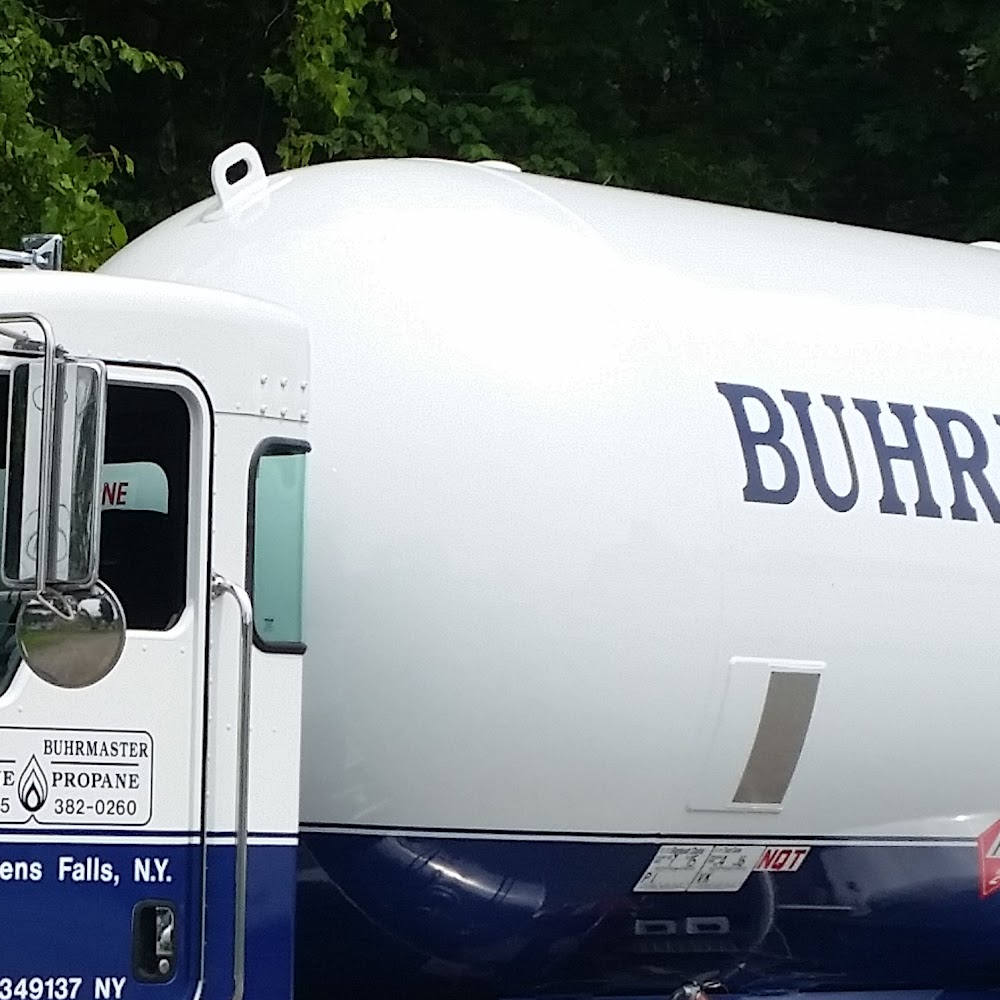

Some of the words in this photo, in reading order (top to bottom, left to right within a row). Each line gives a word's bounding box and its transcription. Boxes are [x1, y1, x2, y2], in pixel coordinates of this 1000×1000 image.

[715, 382, 1000, 523] BUHR
[101, 481, 129, 506] NE
[43, 739, 149, 758] BUHRMASTER
[51, 771, 140, 790] PROPANE
[54, 798, 137, 817] 382-0260
[58, 856, 120, 887] Falls,
[134, 857, 173, 882] N.Y.
[94, 976, 127, 1000] NY
